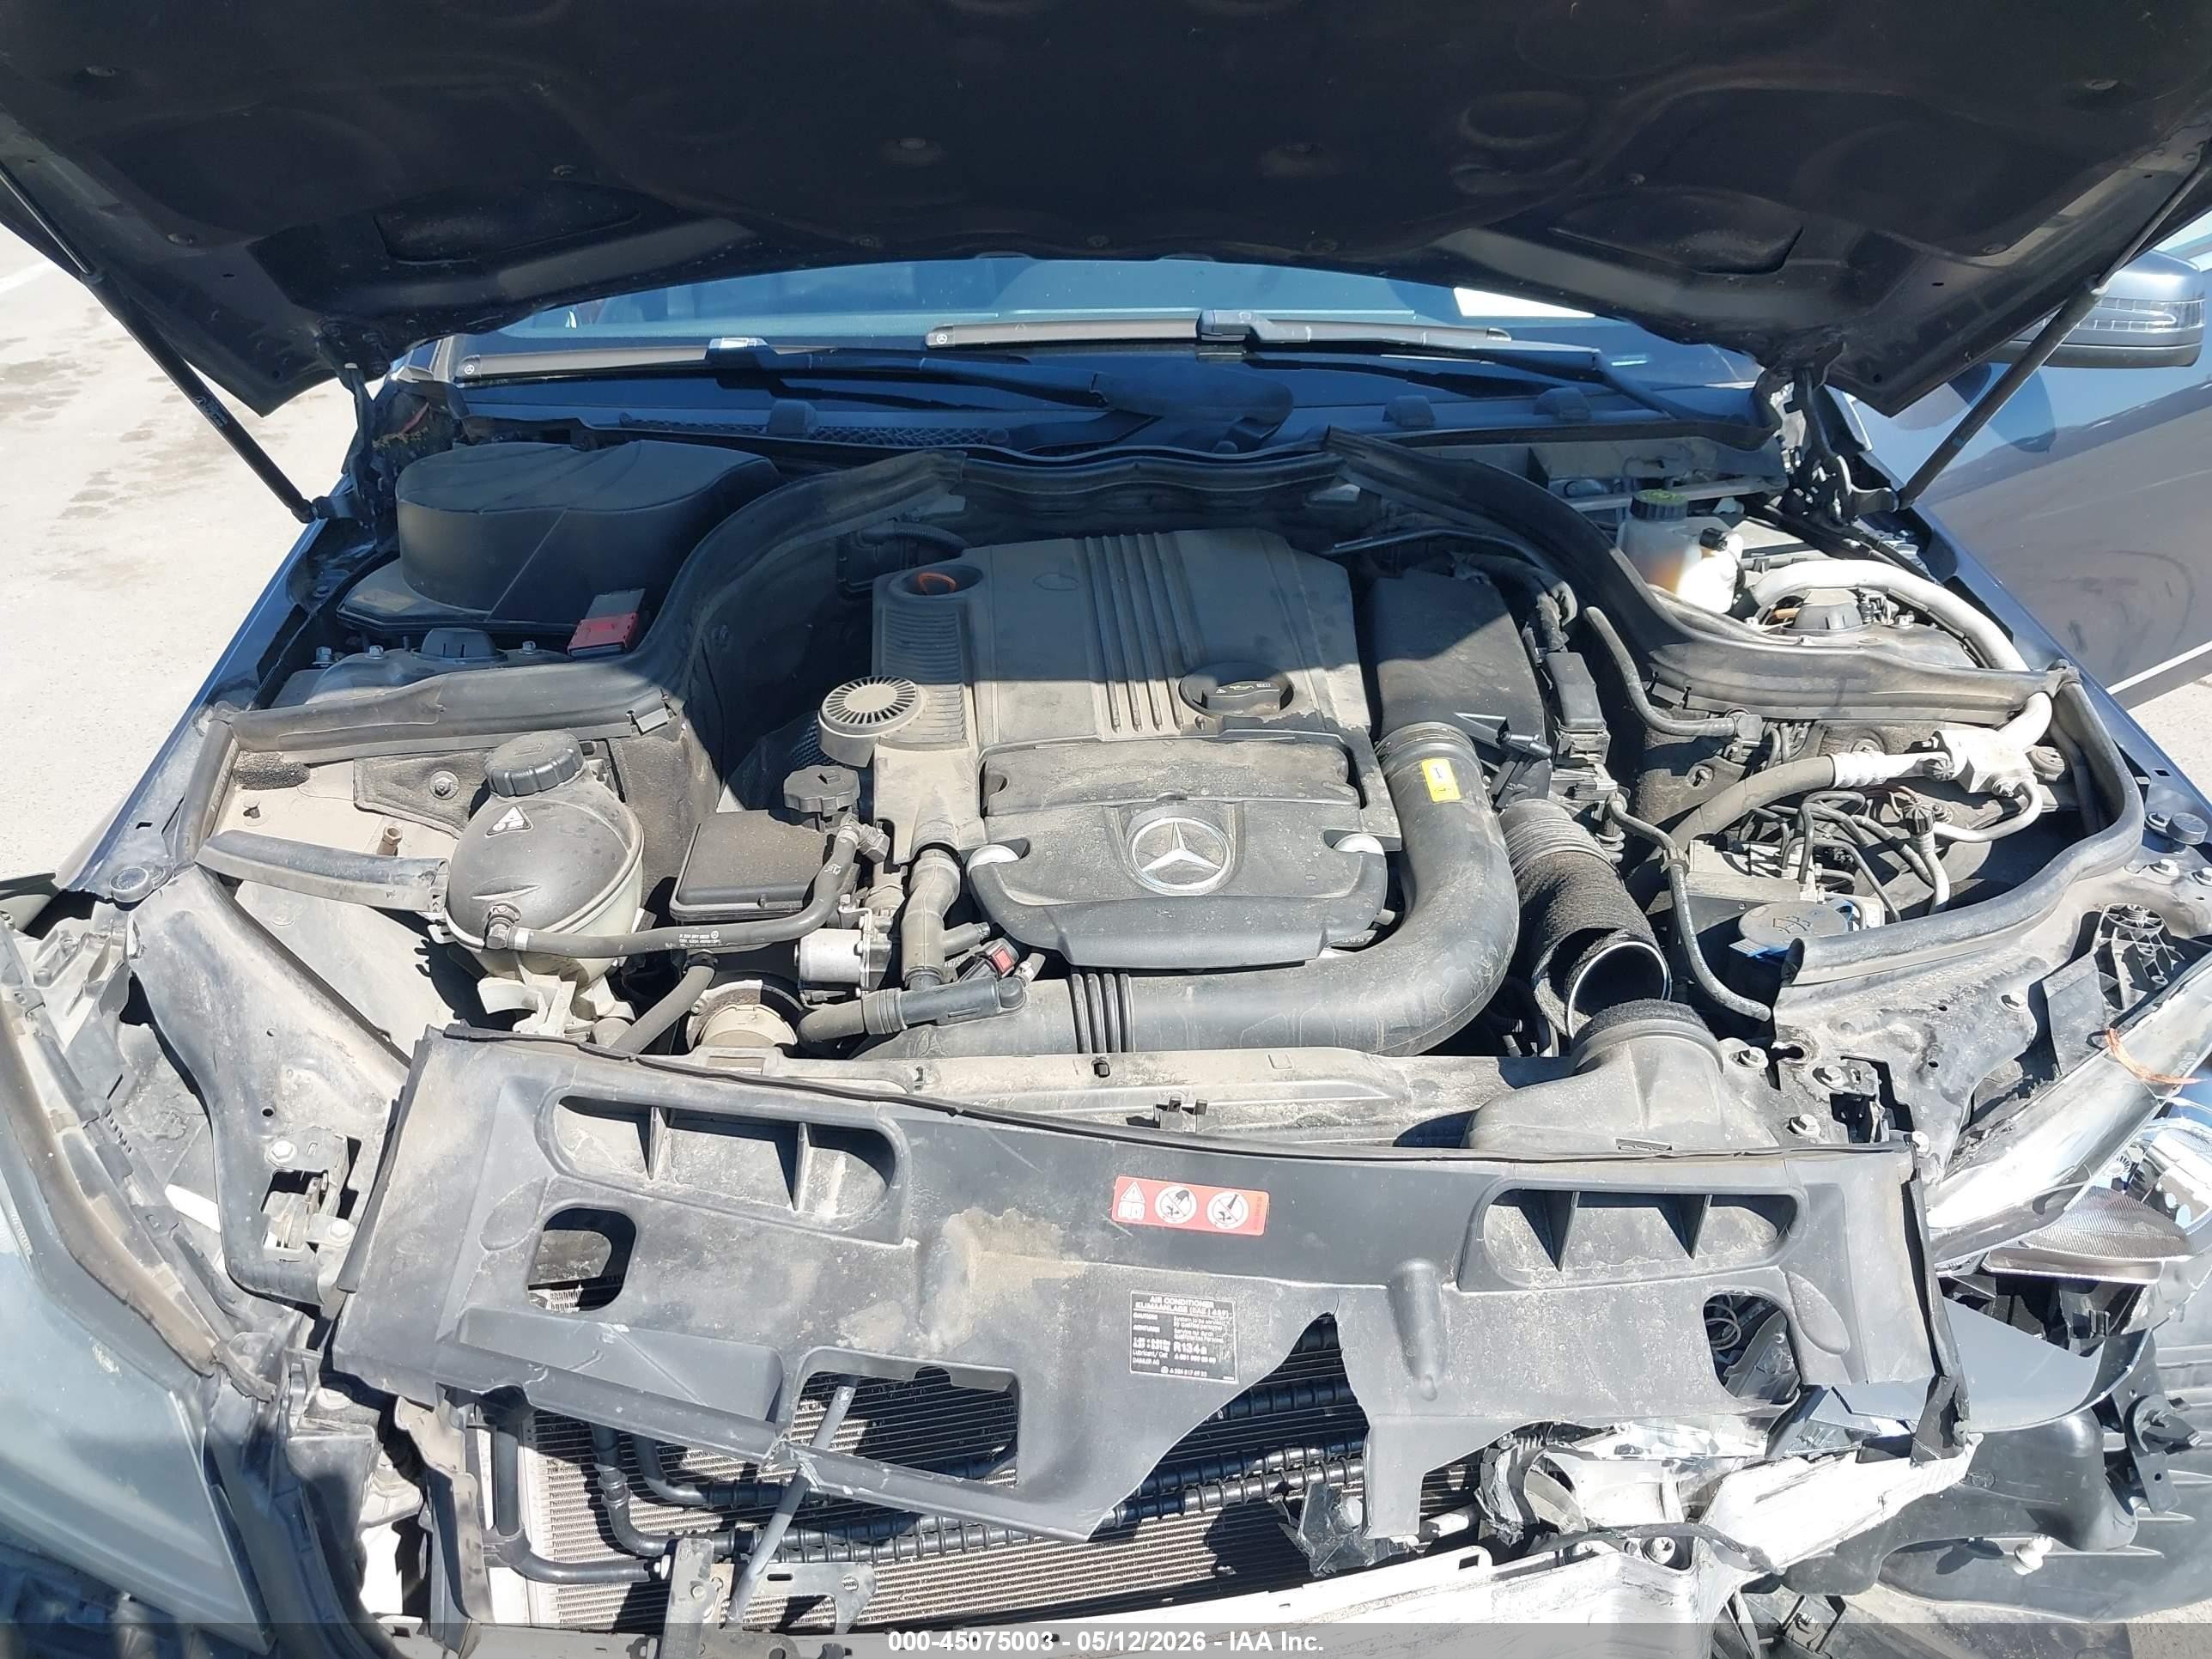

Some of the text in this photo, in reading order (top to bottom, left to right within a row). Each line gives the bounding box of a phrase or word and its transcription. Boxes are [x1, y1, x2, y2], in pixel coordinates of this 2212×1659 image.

[1135, 1301, 1188, 1313] KLIMAANLAGE
[1164, 1297, 1214, 1308] CONDITIONER
[1173, 1341, 1207, 1354] R134a
